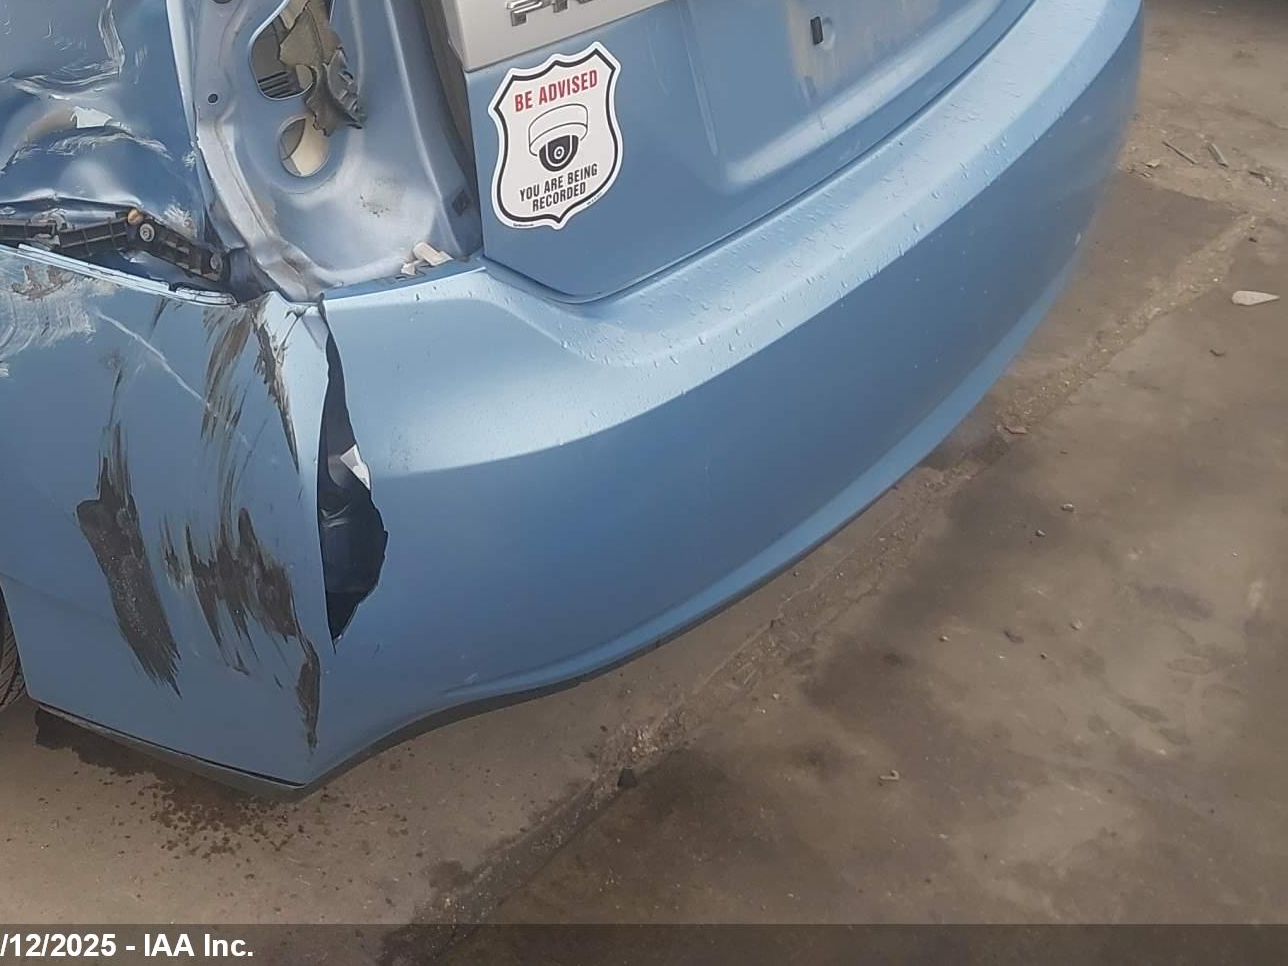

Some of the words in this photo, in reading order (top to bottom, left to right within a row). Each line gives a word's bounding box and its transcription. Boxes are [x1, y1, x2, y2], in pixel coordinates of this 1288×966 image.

[514, 91, 533, 112] BE
[538, 69, 598, 105] ADVISED
[519, 184, 540, 202] YOU
[544, 176, 563, 194] ARE
[567, 163, 598, 186] BEING
[532, 182, 586, 212] RECORDED
